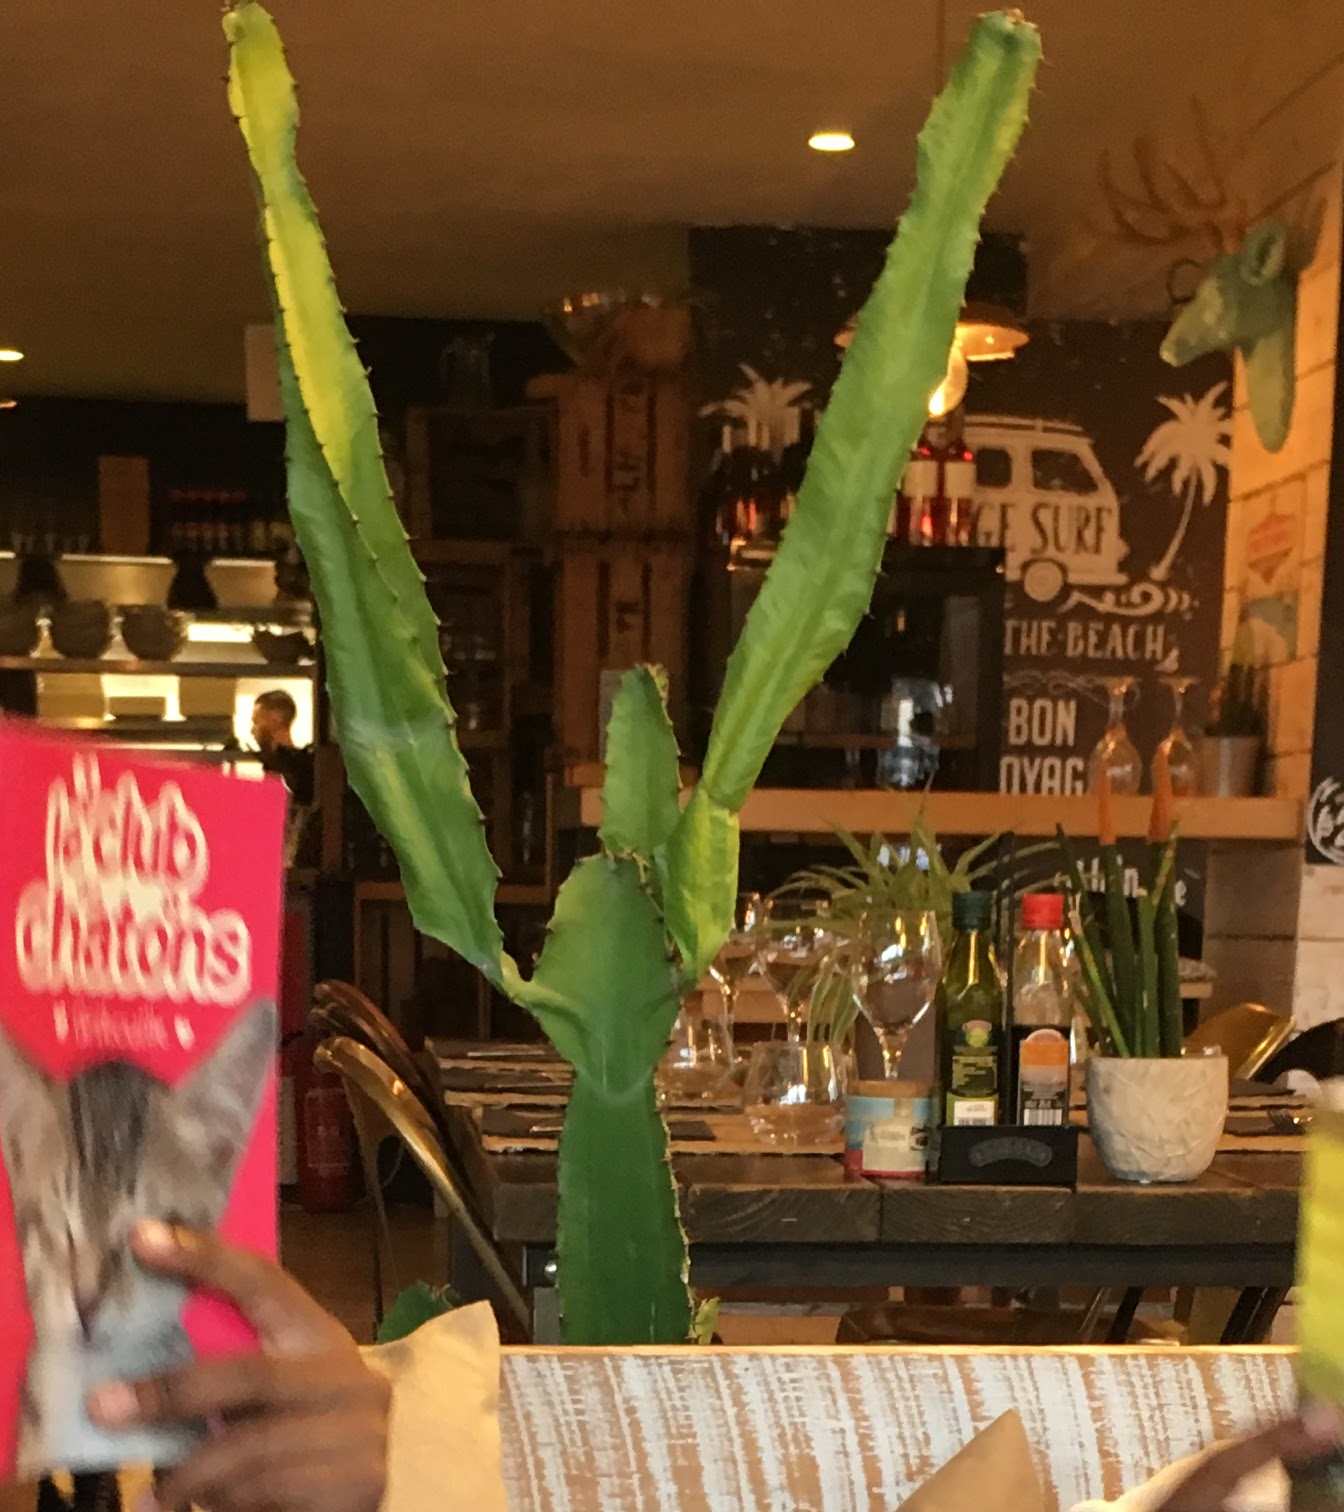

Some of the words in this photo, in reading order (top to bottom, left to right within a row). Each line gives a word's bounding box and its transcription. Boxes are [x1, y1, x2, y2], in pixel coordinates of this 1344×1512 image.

[1029, 503, 1113, 554] SURF
[1005, 618, 1056, 657] THE
[1066, 621, 1166, 662] BEACH
[1008, 697, 1078, 747] BON
